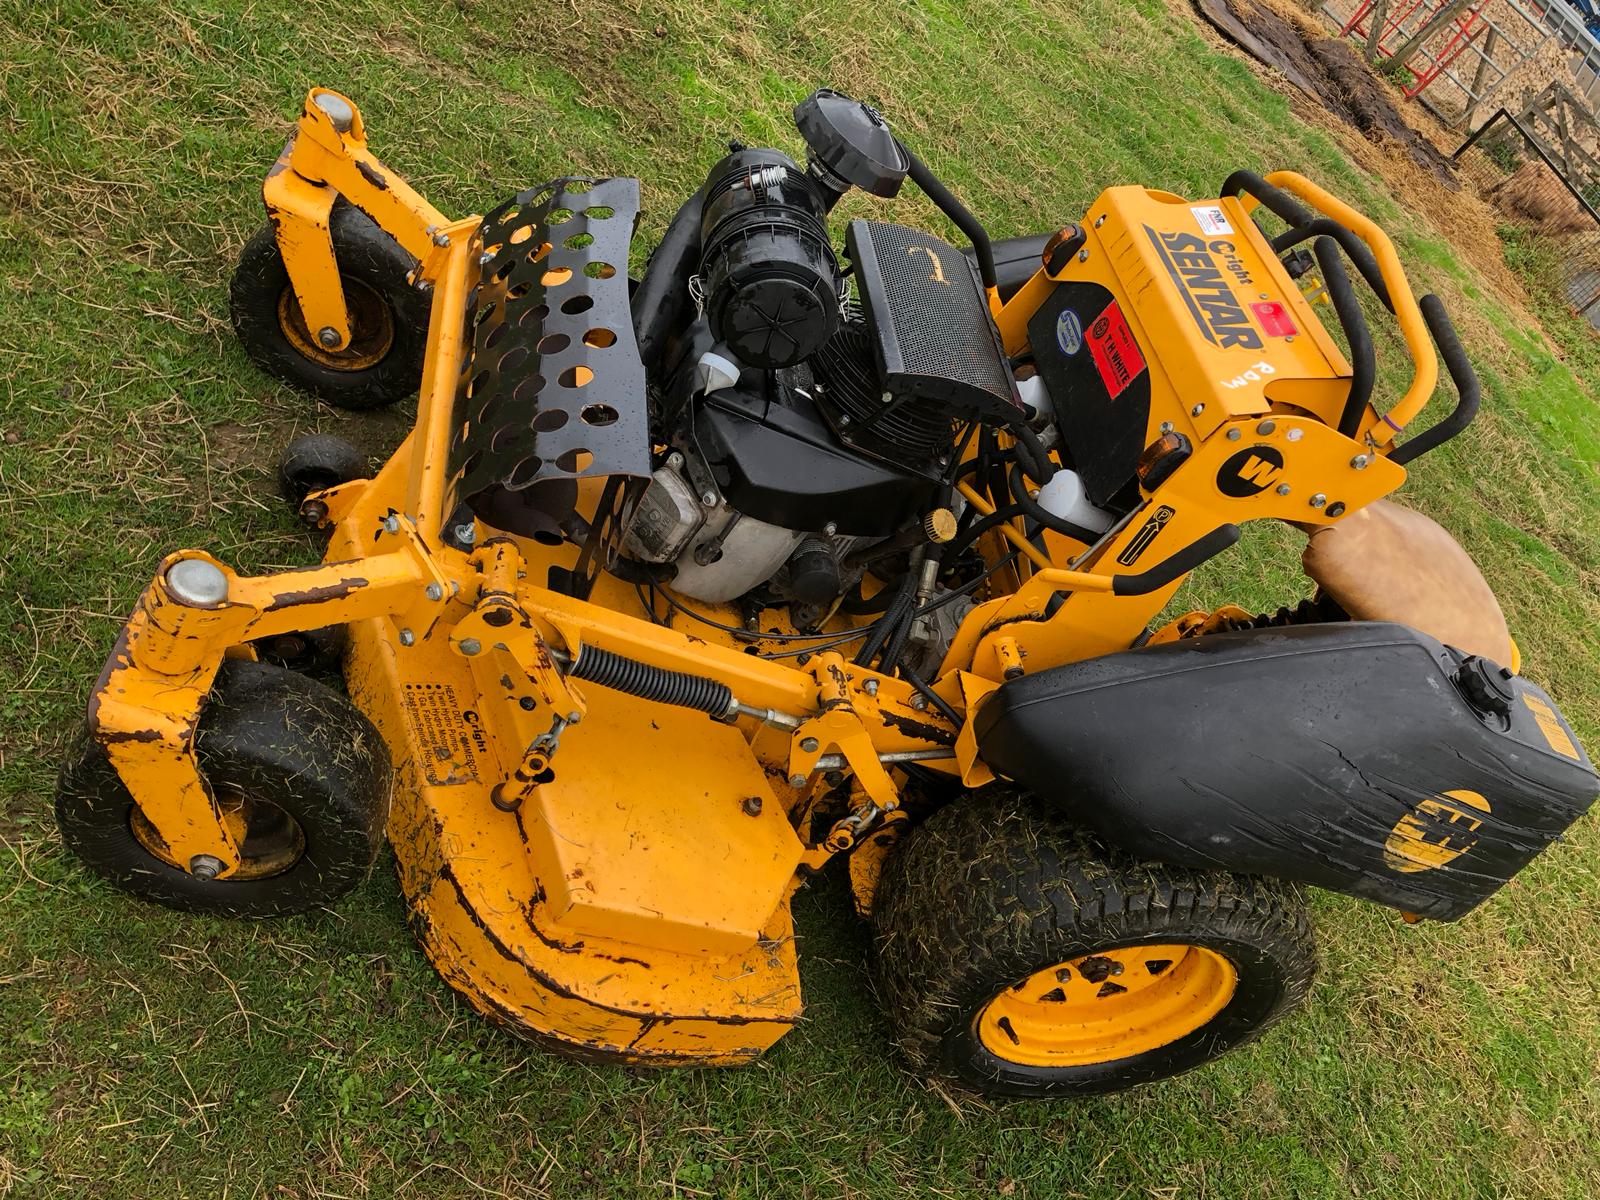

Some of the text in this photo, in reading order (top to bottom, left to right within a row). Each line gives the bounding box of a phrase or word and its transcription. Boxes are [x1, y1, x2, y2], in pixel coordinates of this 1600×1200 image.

[1209, 209, 1226, 224] FNR
[1159, 231, 1264, 350] SENTAR
[1111, 350, 1130, 385] WHITE
[406, 691, 418, 708] Cast
[427, 690, 451, 753] Twin Hydro Motor
[437, 690, 460, 753] Twin Hydro Pumps
[422, 708, 439, 748] Fabricated
[444, 684, 480, 779] HEAVY DUTY CMMERCIA
